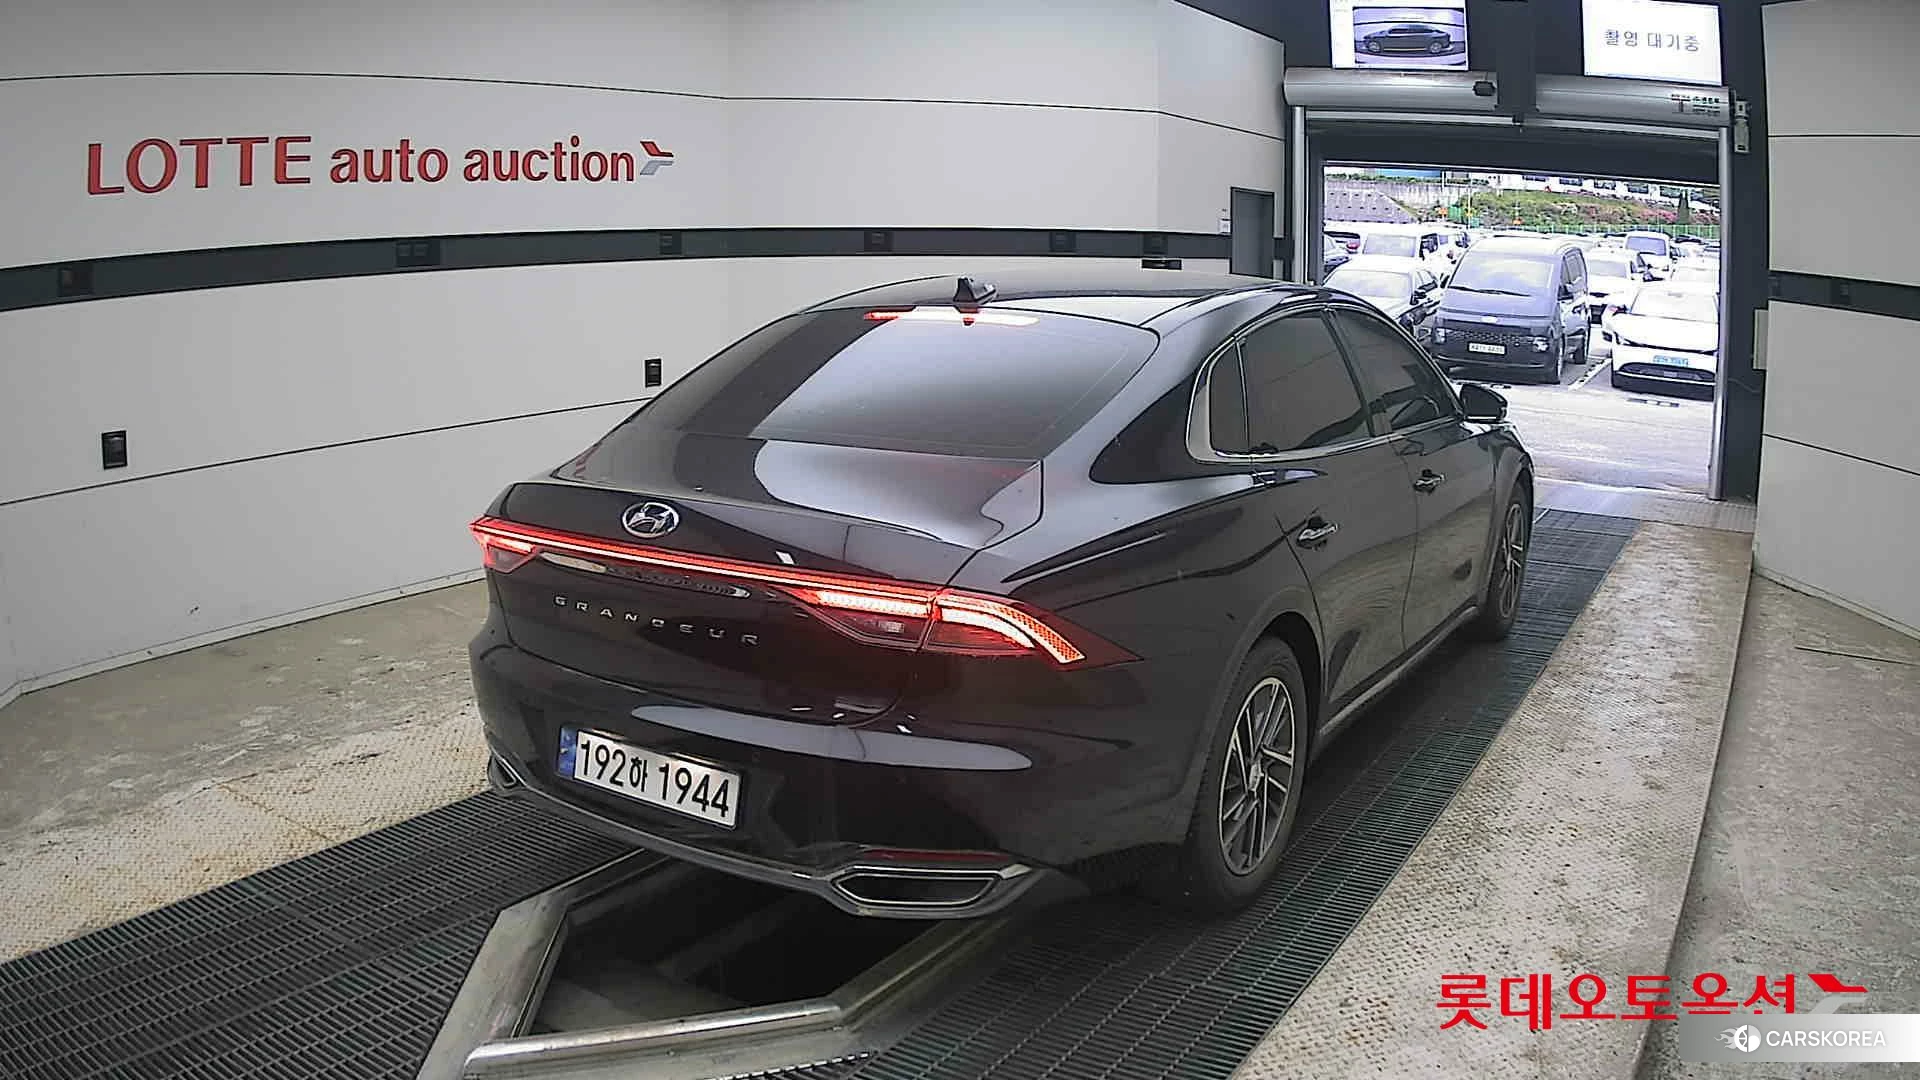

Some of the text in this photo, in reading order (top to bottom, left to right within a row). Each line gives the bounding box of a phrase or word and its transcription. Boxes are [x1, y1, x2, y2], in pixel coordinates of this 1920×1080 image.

[1646, 32, 1700, 52] 대기중
[87, 135, 636, 196] LOTTE auto auction
[554, 595, 760, 646] GRANDEUR
[580, 739, 730, 818] 192하 1944
